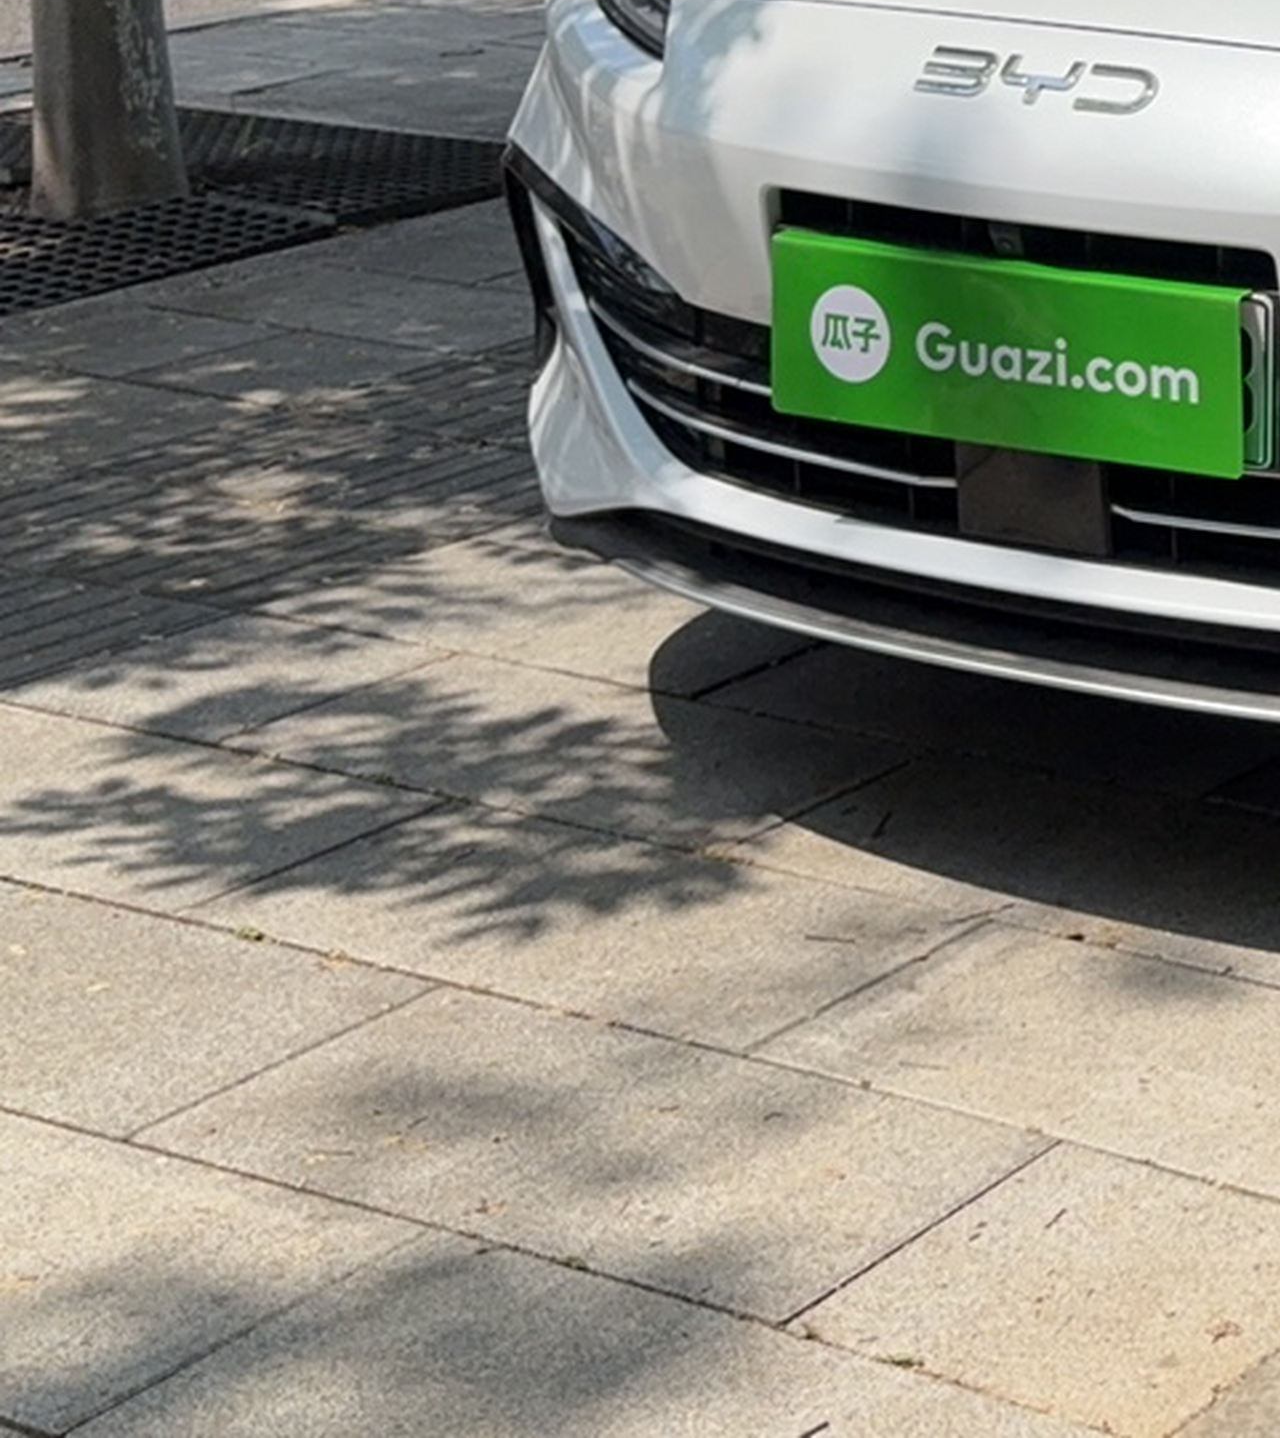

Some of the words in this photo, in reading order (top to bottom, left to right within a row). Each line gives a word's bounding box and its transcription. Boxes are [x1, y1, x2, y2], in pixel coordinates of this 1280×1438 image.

[913, 45, 1160, 115] BYD
[821, 313, 881, 353] 瓜子
[914, 321, 1200, 404] Guazi.com
